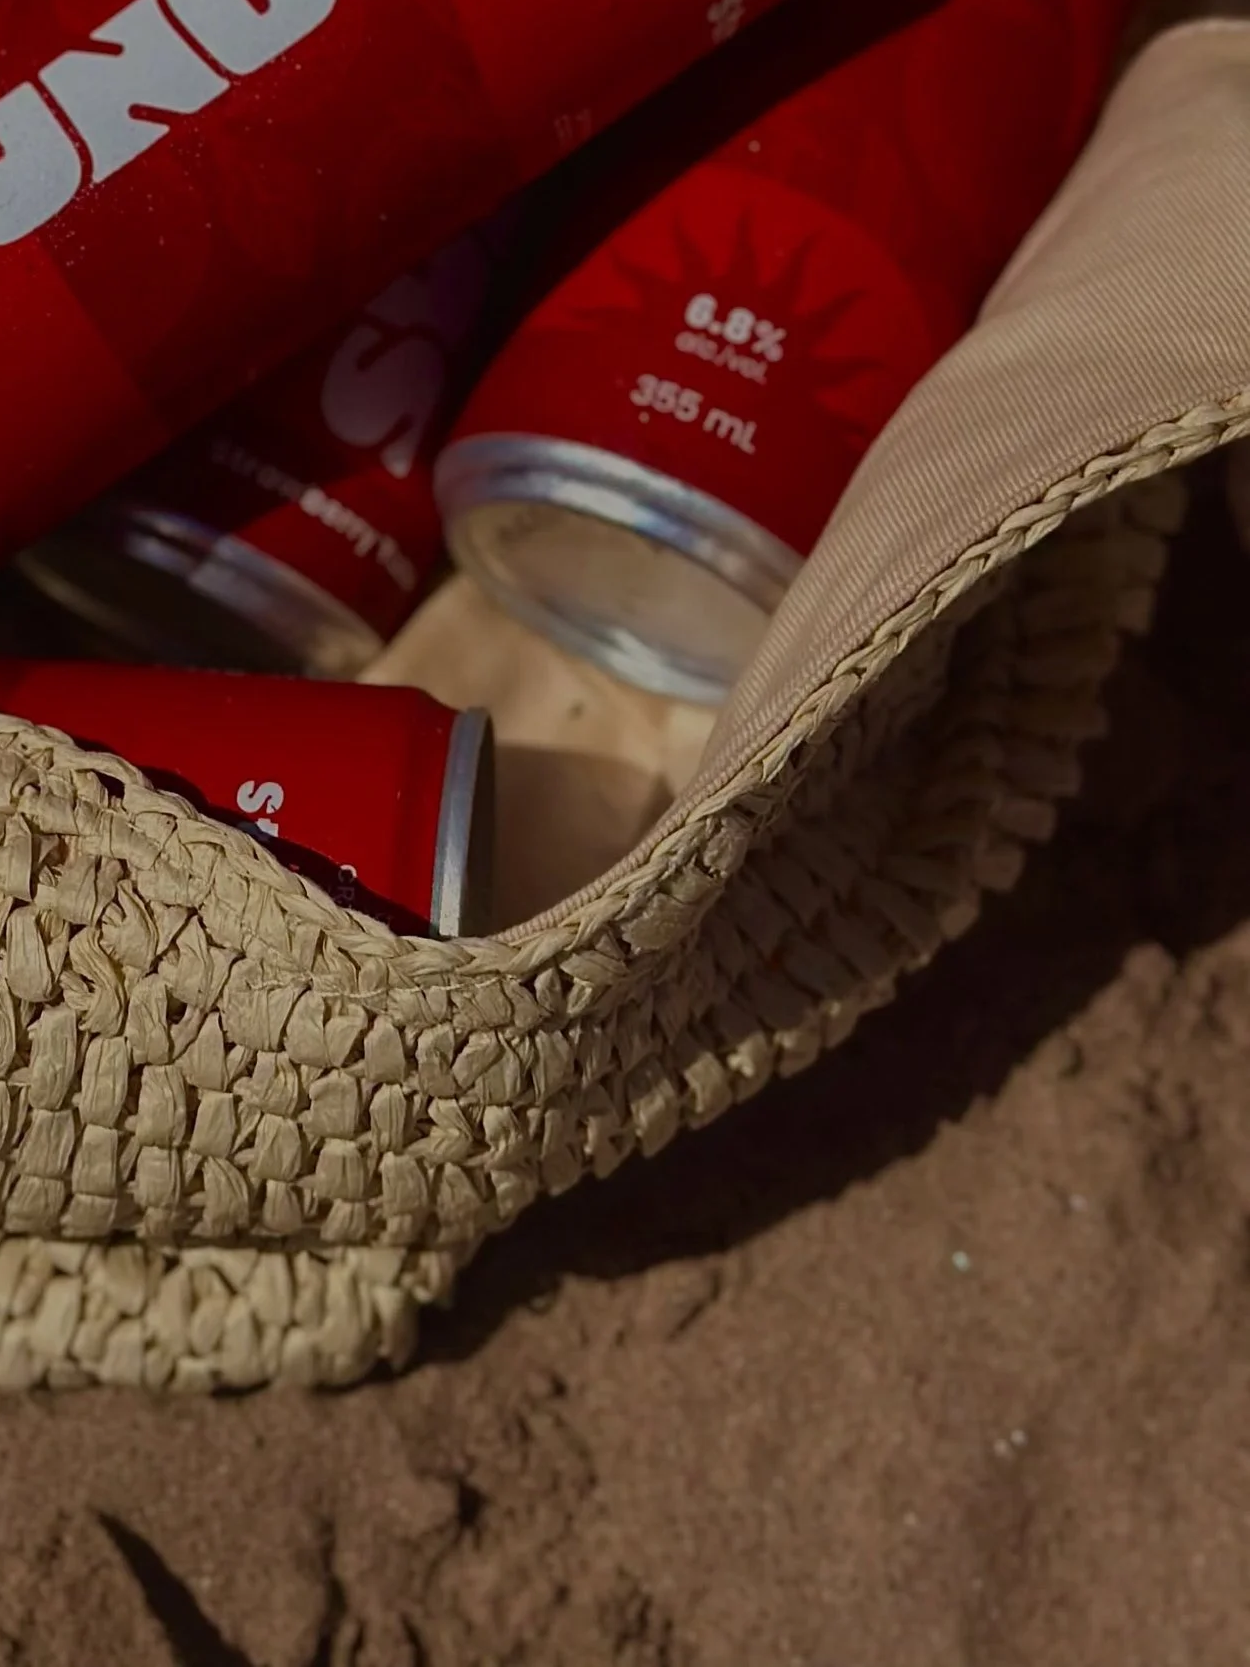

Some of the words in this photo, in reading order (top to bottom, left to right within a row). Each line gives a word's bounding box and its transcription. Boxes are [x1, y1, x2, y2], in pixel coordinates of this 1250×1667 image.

[684, 293, 786, 362] 6.8%
[629, 373, 704, 422] 355
[702, 407, 757, 454] mL
